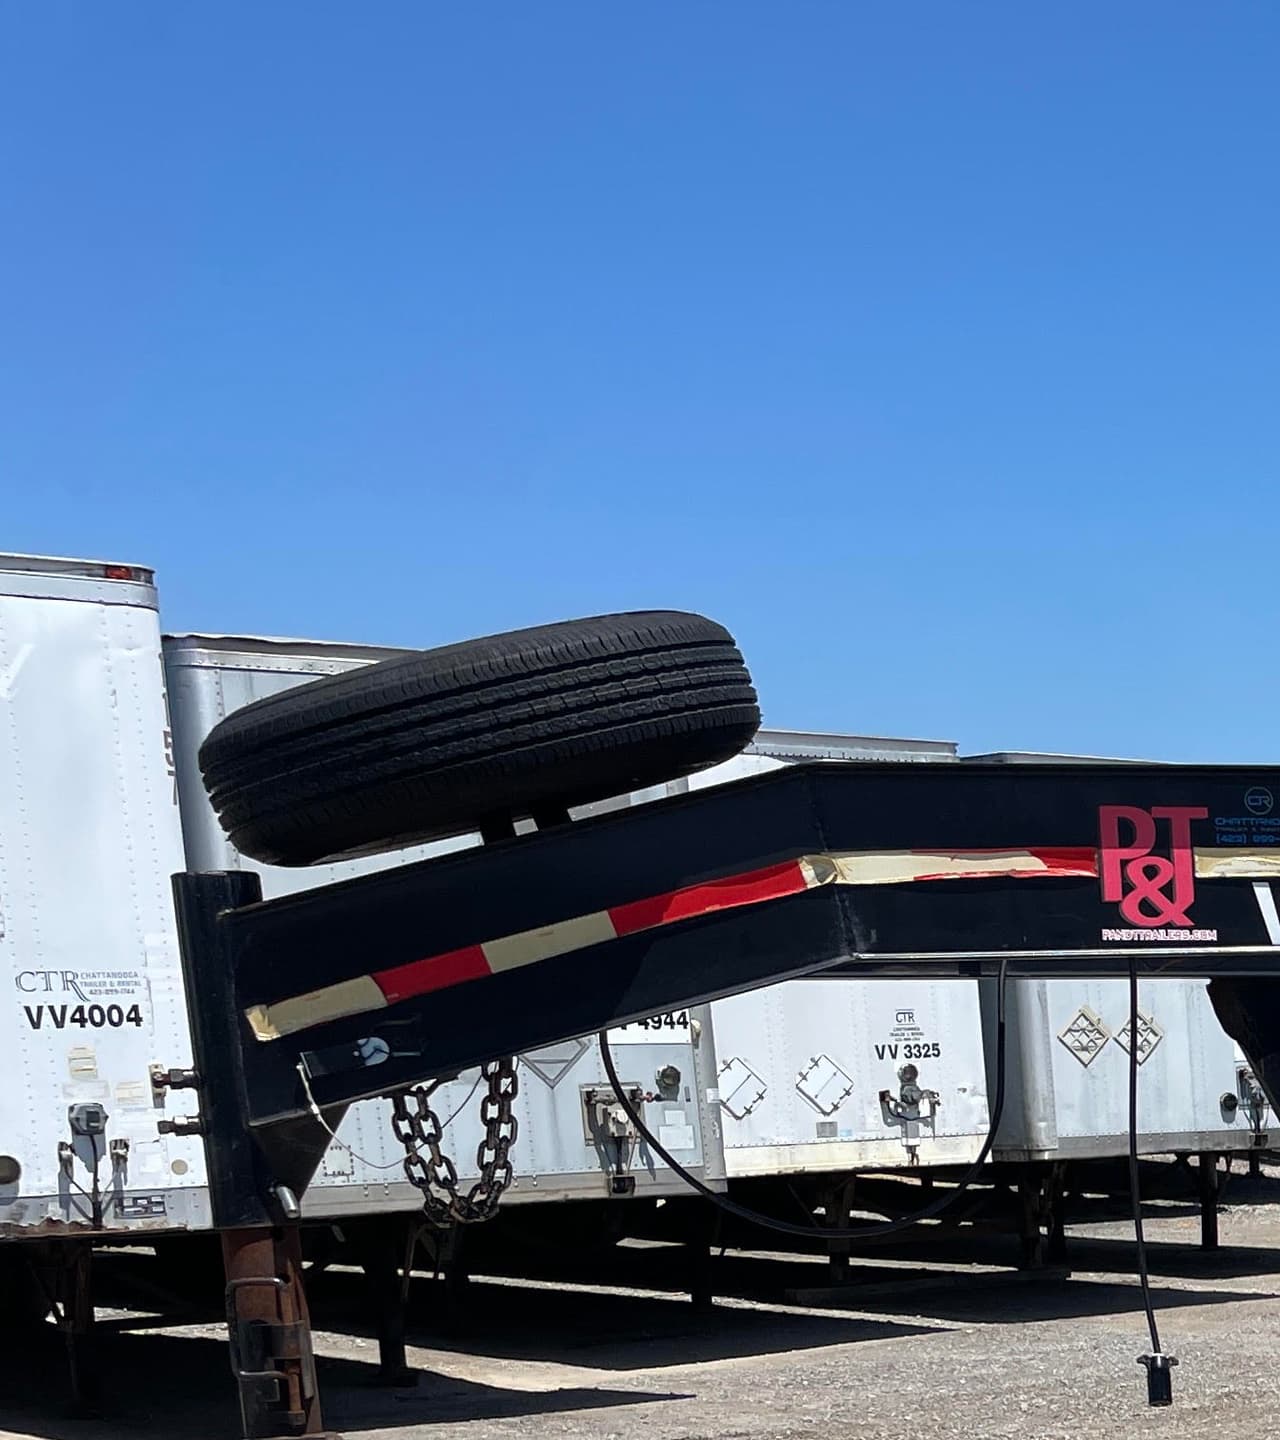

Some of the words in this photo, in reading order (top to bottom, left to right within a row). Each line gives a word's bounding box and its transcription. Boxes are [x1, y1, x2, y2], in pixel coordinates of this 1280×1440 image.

[15, 971, 91, 1002] CTR
[638, 1011, 690, 1030] 4944
[874, 1044, 898, 1060] VV
[904, 1043, 941, 1059] 3325
